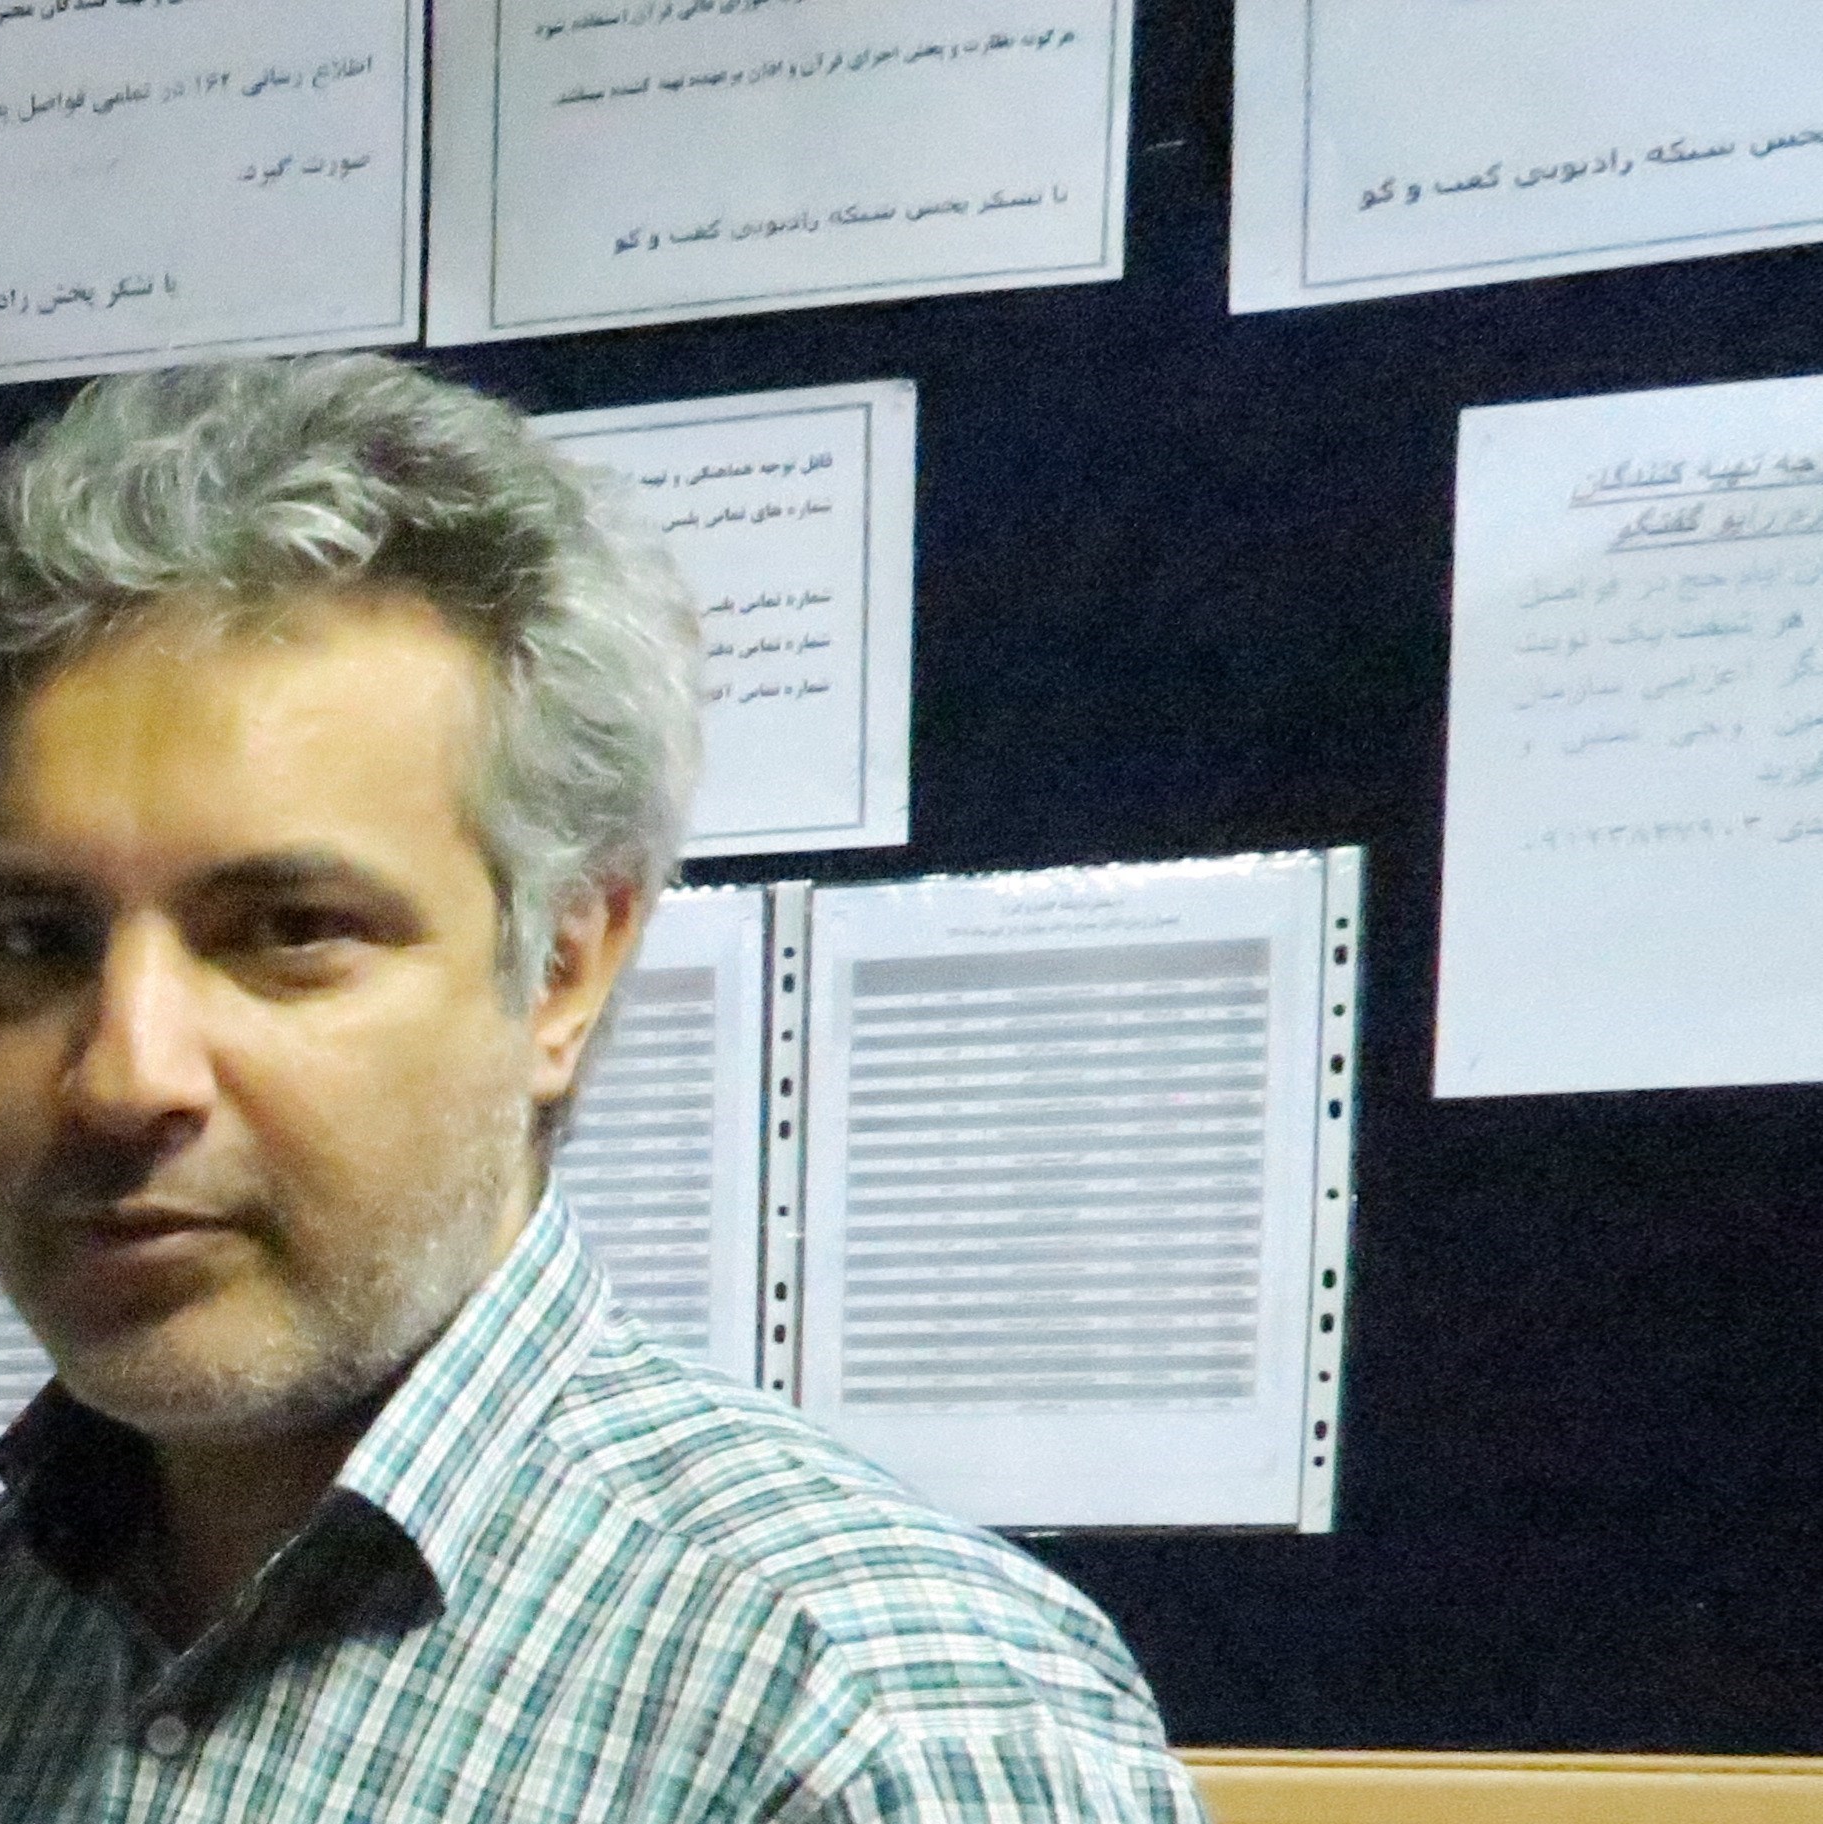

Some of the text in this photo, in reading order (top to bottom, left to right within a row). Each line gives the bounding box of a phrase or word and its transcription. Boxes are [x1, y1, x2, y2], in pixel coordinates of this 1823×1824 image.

[241, 66, 304, 98] رسانی
[311, 54, 373, 90] اطلاع
[160, 81, 186, 104] در
[1644, 136, 1736, 164] شبکه
[300, 153, 372, 181] صورت
[1433, 160, 1504, 196] گفت
[976, 189, 1044, 216] تشکر
[1052, 184, 1069, 204] با
[1358, 176, 1396, 213] گو
[1404, 182, 1422, 207] و
[828, 204, 897, 226] شبکه
[614, 226, 643, 257] گو
[647, 232, 661, 252] و
[669, 218, 722, 245] گفت
[105, 274, 154, 311] تشکر
[164, 272, 177, 296] با
[37, 282, 96, 316] پخش
